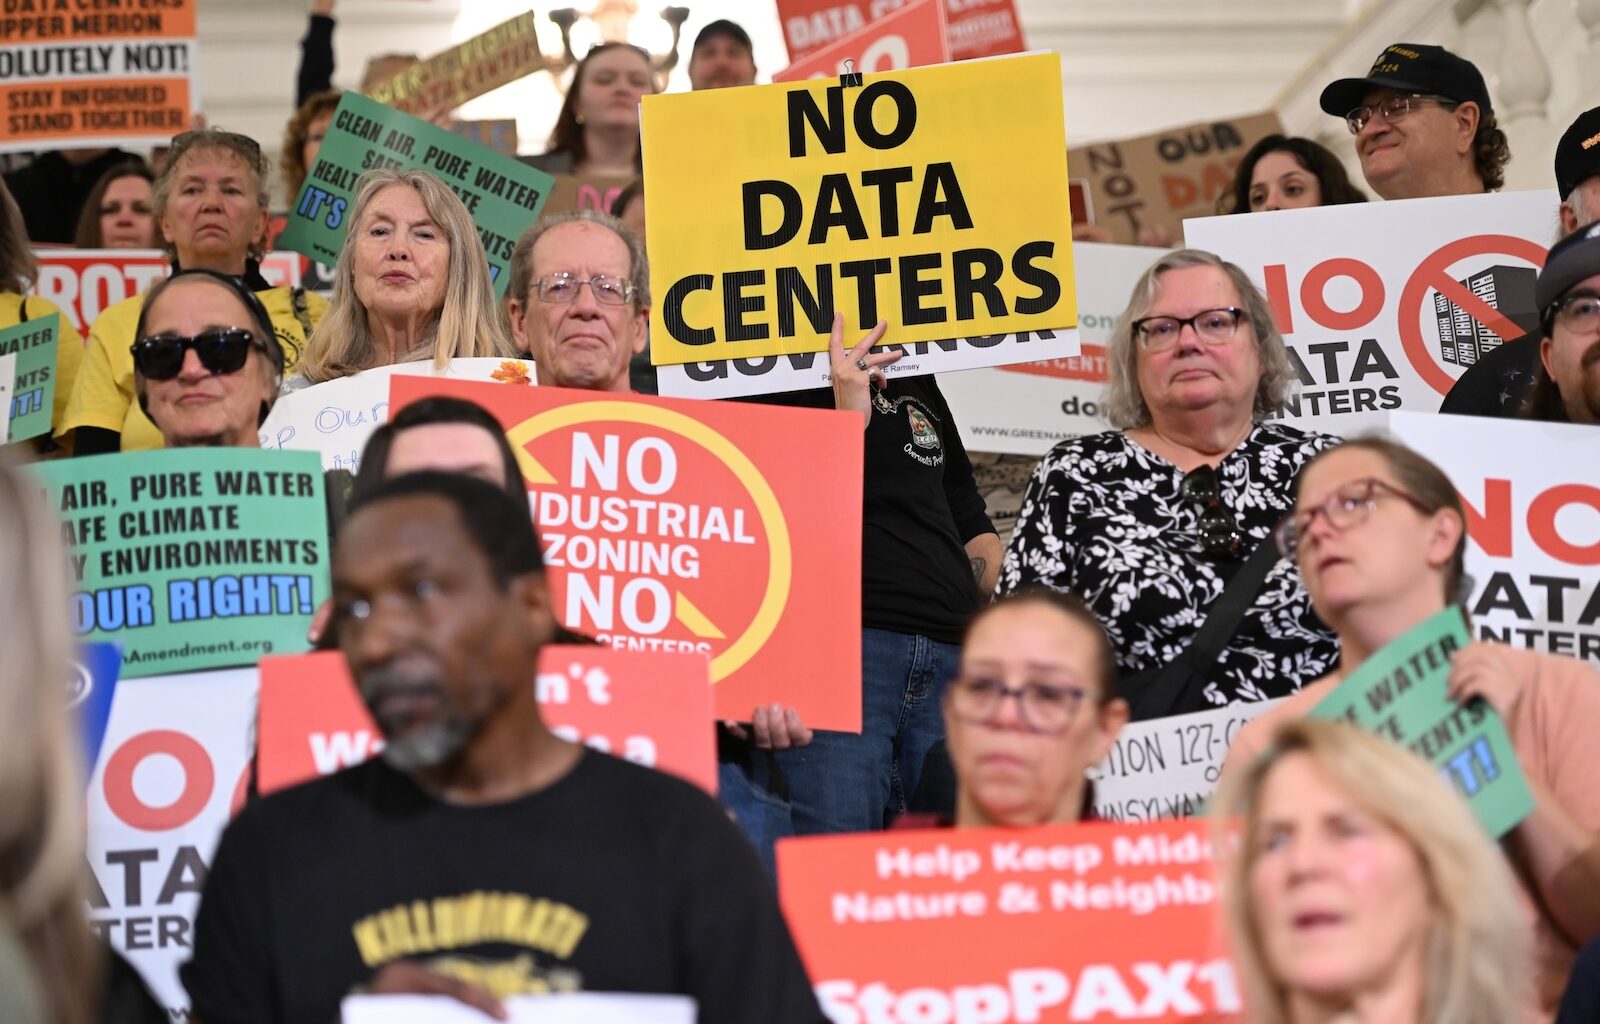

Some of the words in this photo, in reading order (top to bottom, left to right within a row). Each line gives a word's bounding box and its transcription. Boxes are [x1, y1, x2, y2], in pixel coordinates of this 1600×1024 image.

[0, 16, 65, 38] PPER
[71, 14, 163, 33] MERION
[124, 43, 189, 74] NOT!
[8, 91, 53, 111] STAY
[61, 86, 167, 107] INFORMED
[787, 80, 917, 158] NO
[8, 112, 73, 135] STAND
[80, 108, 183, 131] TOGETHER
[1157, 122, 1243, 163] OUR
[312, 158, 357, 192] HEALT
[335, 109, 384, 144] CLEAN
[383, 128, 417, 161] AIR,
[422, 145, 472, 180] PURE
[473, 165, 541, 212] WATER
[297, 184, 349, 230] IT'S
[742, 161, 974, 251] DATA
[662, 240, 1061, 346] CENTERS
[890, 363, 920, 372] Ramsey
[1053, 353, 1107, 374] CENT
[1288, 338, 1400, 386] ATA
[1266, 385, 1403, 420] NTERS
[971, 426, 1085, 440] WWW.GREENAM
[570, 431, 678, 496] NO
[61, 481, 118, 512] AIR,
[130, 472, 203, 502] PURE
[214, 471, 315, 498] WATER
[61, 515, 107, 547] AFE
[118, 505, 241, 540] CLIMATE
[101, 538, 320, 578] ENVIRONMENTS
[542, 533, 700, 579] ZONING
[69, 583, 155, 636] OUR
[167, 574, 315, 624] RIGHT!
[565, 572, 672, 635] NO
[1472, 571, 1600, 626] AT
[534, 662, 612, 706] n't
[103, 729, 215, 833] O
[86, 845, 210, 910] TA
[876, 845, 981, 882] Help
[990, 841, 1101, 876] Keep
[832, 889, 986, 924] Nature
[997, 882, 1041, 913] &
